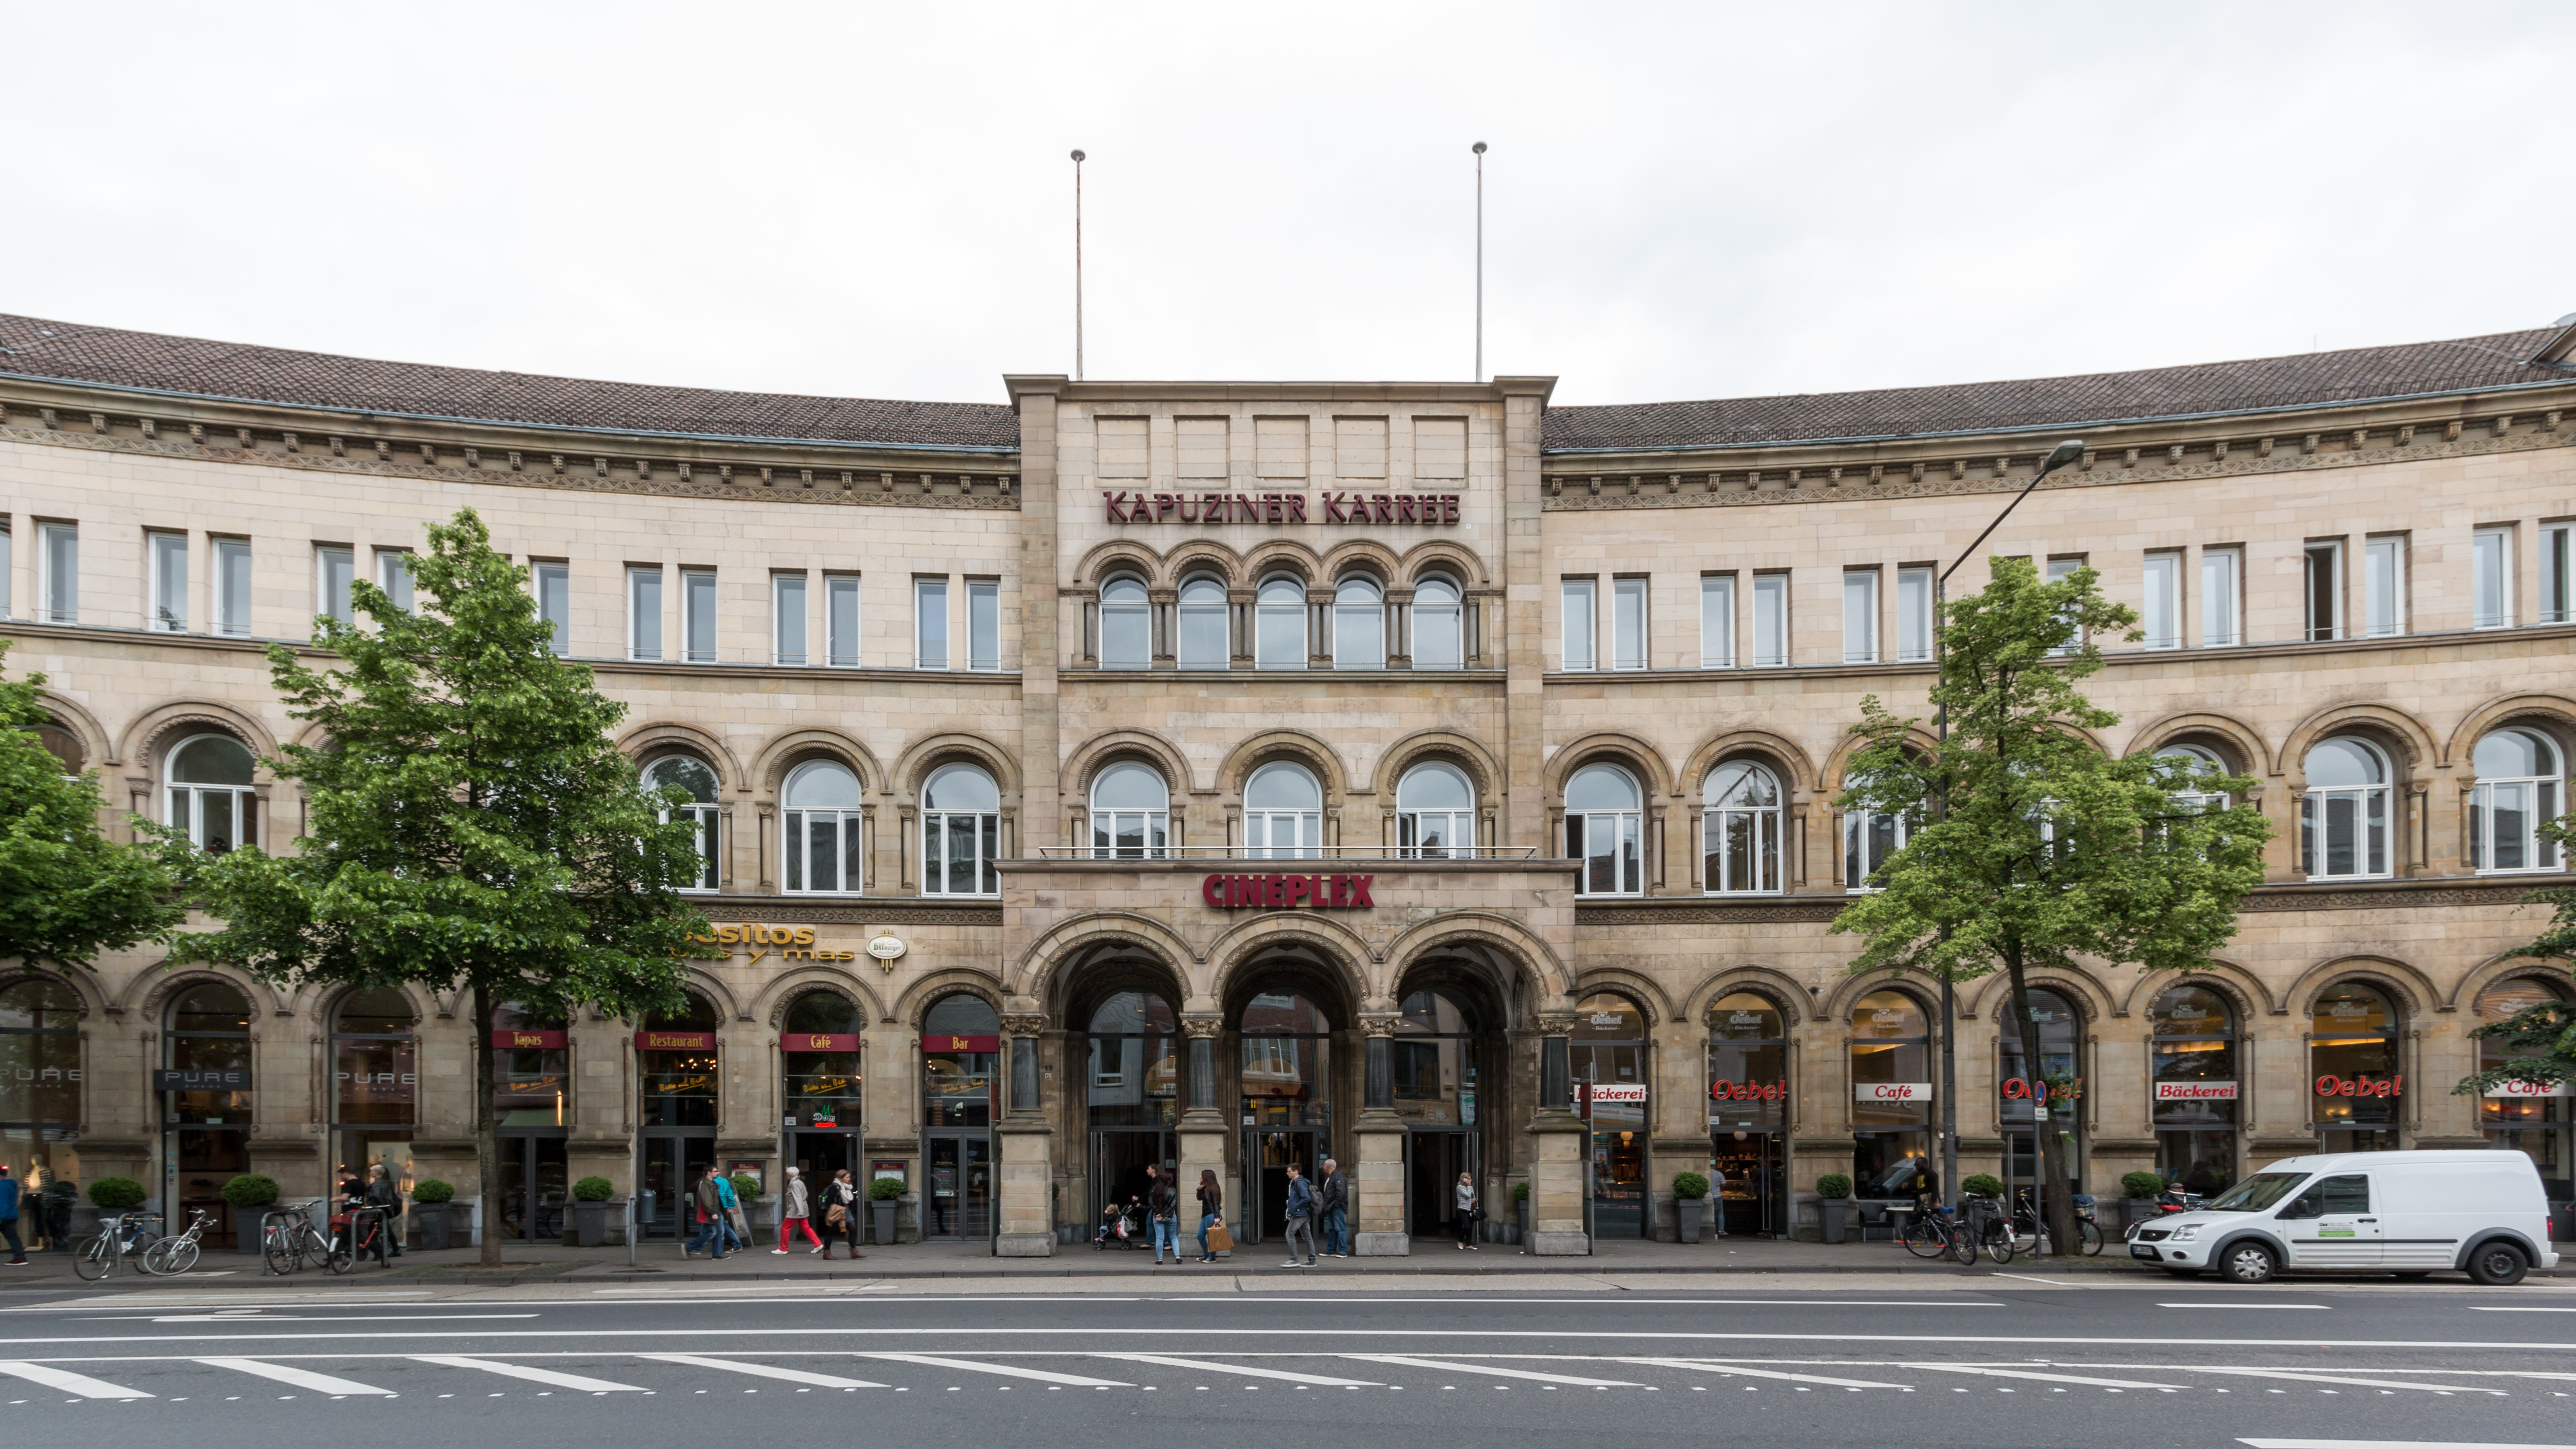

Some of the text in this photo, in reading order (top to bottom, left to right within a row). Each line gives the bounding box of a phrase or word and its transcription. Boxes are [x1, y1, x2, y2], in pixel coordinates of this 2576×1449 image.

[1103, 491, 1461, 523] KAPUZINER KARREE
[1202, 874, 1375, 907] CINEPLEX
[669, 921, 815, 945] esitos
[873, 942, 901, 951] Bitburger
[749, 950, 855, 964] y mas
[1872, 1012, 1905, 1022] Oebel
[2331, 1006, 2369, 1016] Oebel
[1590, 1015, 1622, 1025] Oebel
[1730, 1015, 1762, 1024] Oebel
[513, 1032, 542, 1048] Tapas
[650, 1034, 703, 1047] Restaurant
[811, 1035, 831, 1049] Café
[953, 1036, 969, 1049] Bar
[165, 1072, 240, 1082] PURE
[334, 1072, 415, 1084] PURE
[1713, 1079, 1786, 1100] Oebel
[2159, 1085, 2236, 1097] Bäckerei
[2315, 1074, 2402, 1096] Oebel
[1875, 1085, 1912, 1100] Café
[812, 1112, 835, 1122] Dom
